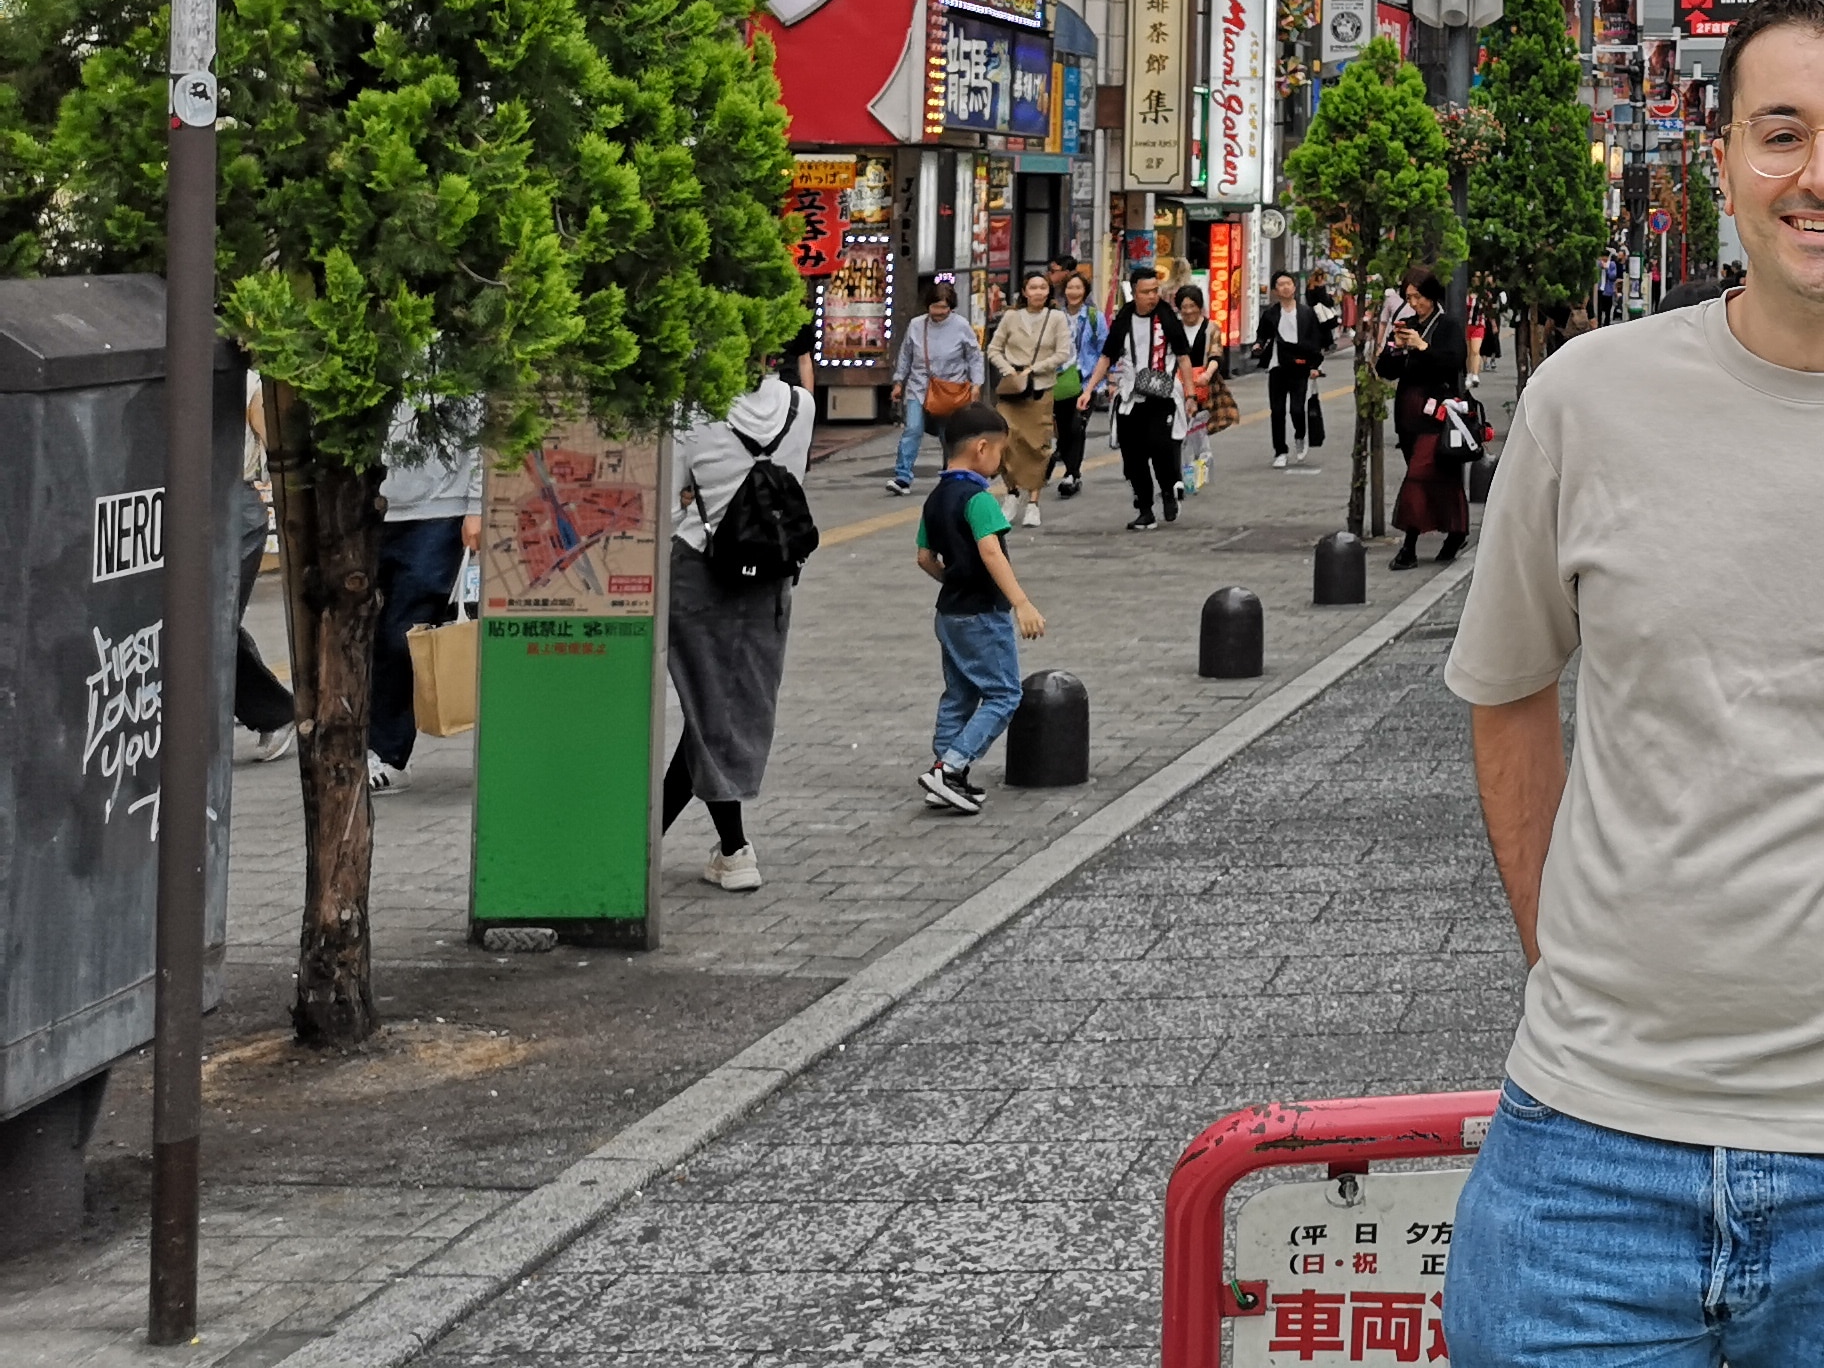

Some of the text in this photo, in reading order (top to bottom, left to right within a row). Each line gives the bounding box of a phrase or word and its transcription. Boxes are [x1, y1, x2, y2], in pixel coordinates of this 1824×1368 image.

[1138, 89, 1175, 125] 集
[1144, 157, 1165, 170] 2F
[488, 620, 574, 637] 貼り紙禁止
[1419, 1252, 1446, 1276] 正
